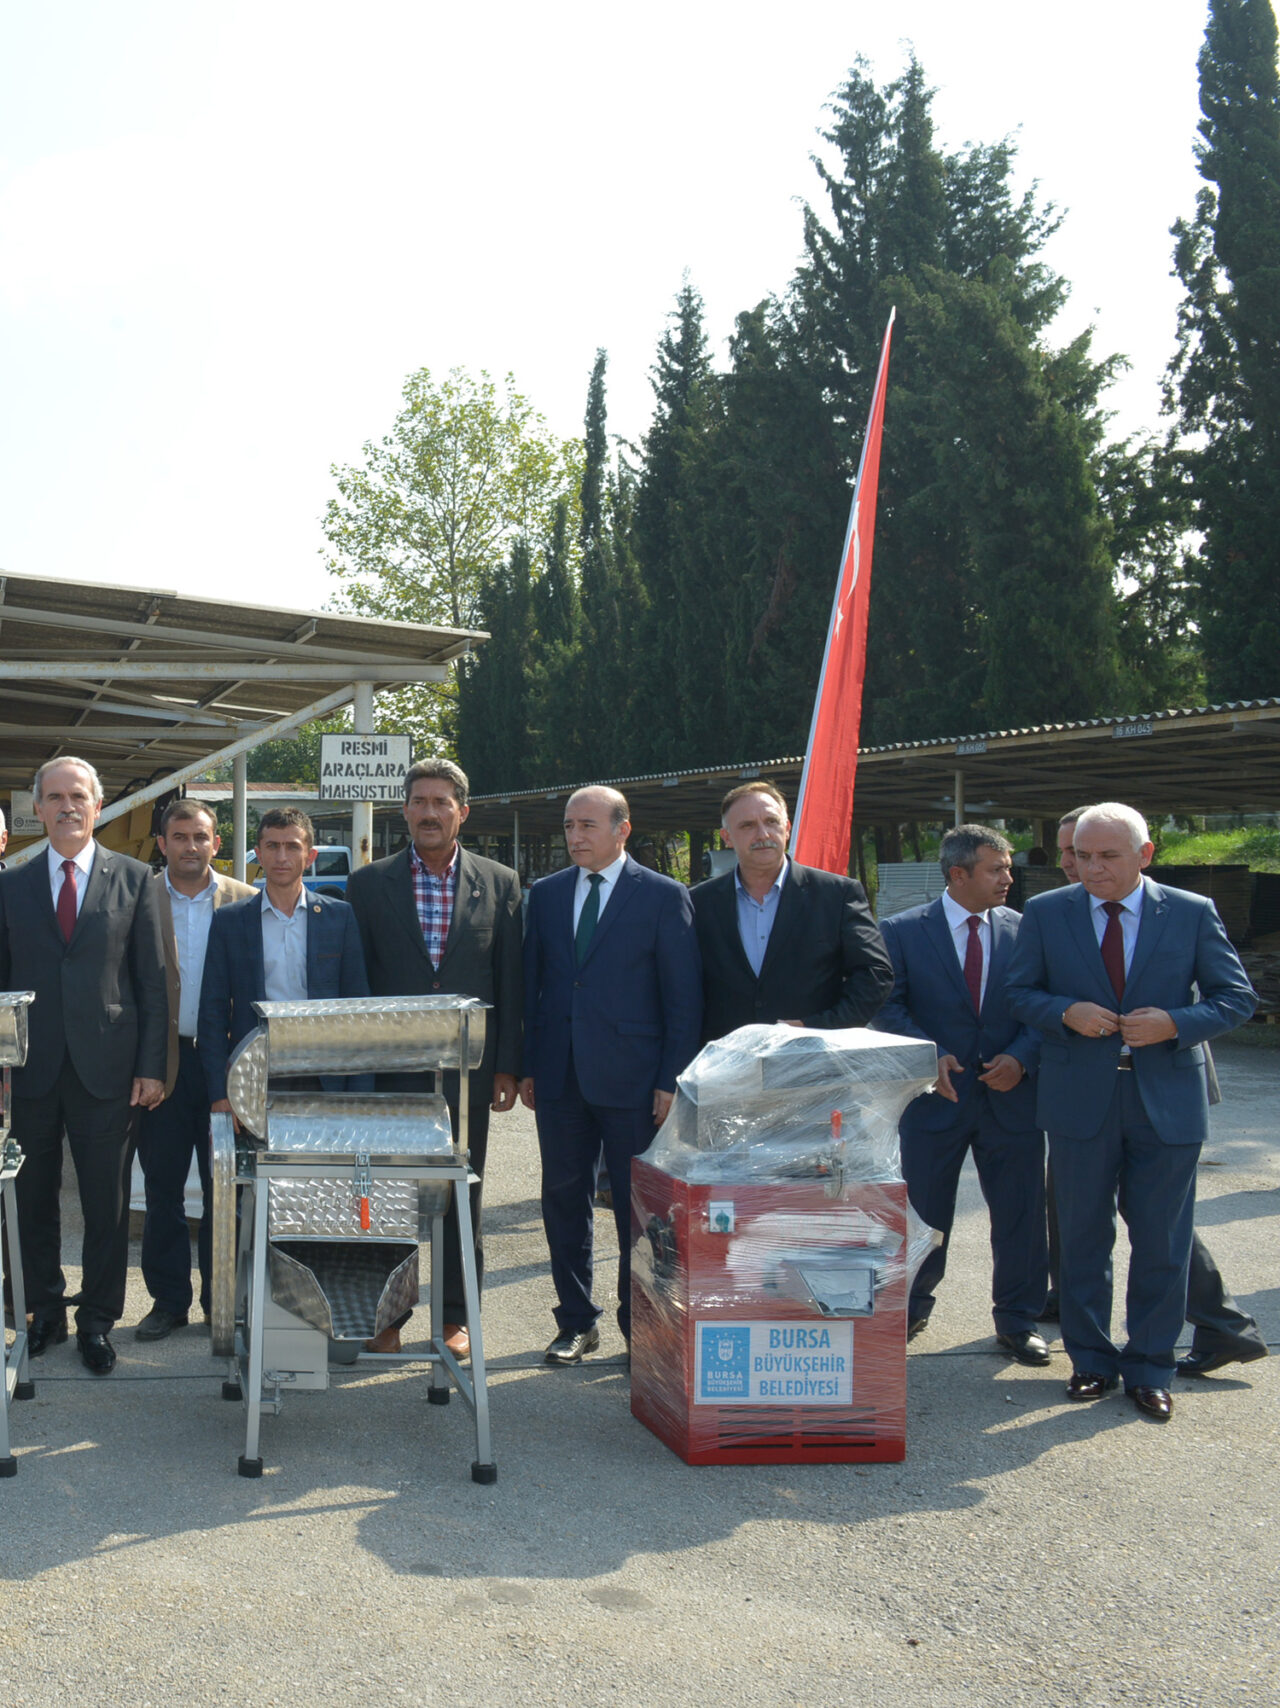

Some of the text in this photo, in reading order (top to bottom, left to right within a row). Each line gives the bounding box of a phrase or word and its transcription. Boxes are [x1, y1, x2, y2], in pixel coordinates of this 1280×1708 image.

[341, 739, 388, 756] RESMİ
[322, 762, 407, 781] ARAÇLARA
[321, 784, 406, 799] MAHSUSTUR
[769, 1328, 831, 1349] BURSA
[754, 1353, 845, 1375] BÜYÜKŞEHİR
[707, 1371, 743, 1379] BURSA
[759, 1377, 839, 1396] BELEDİYESİ
